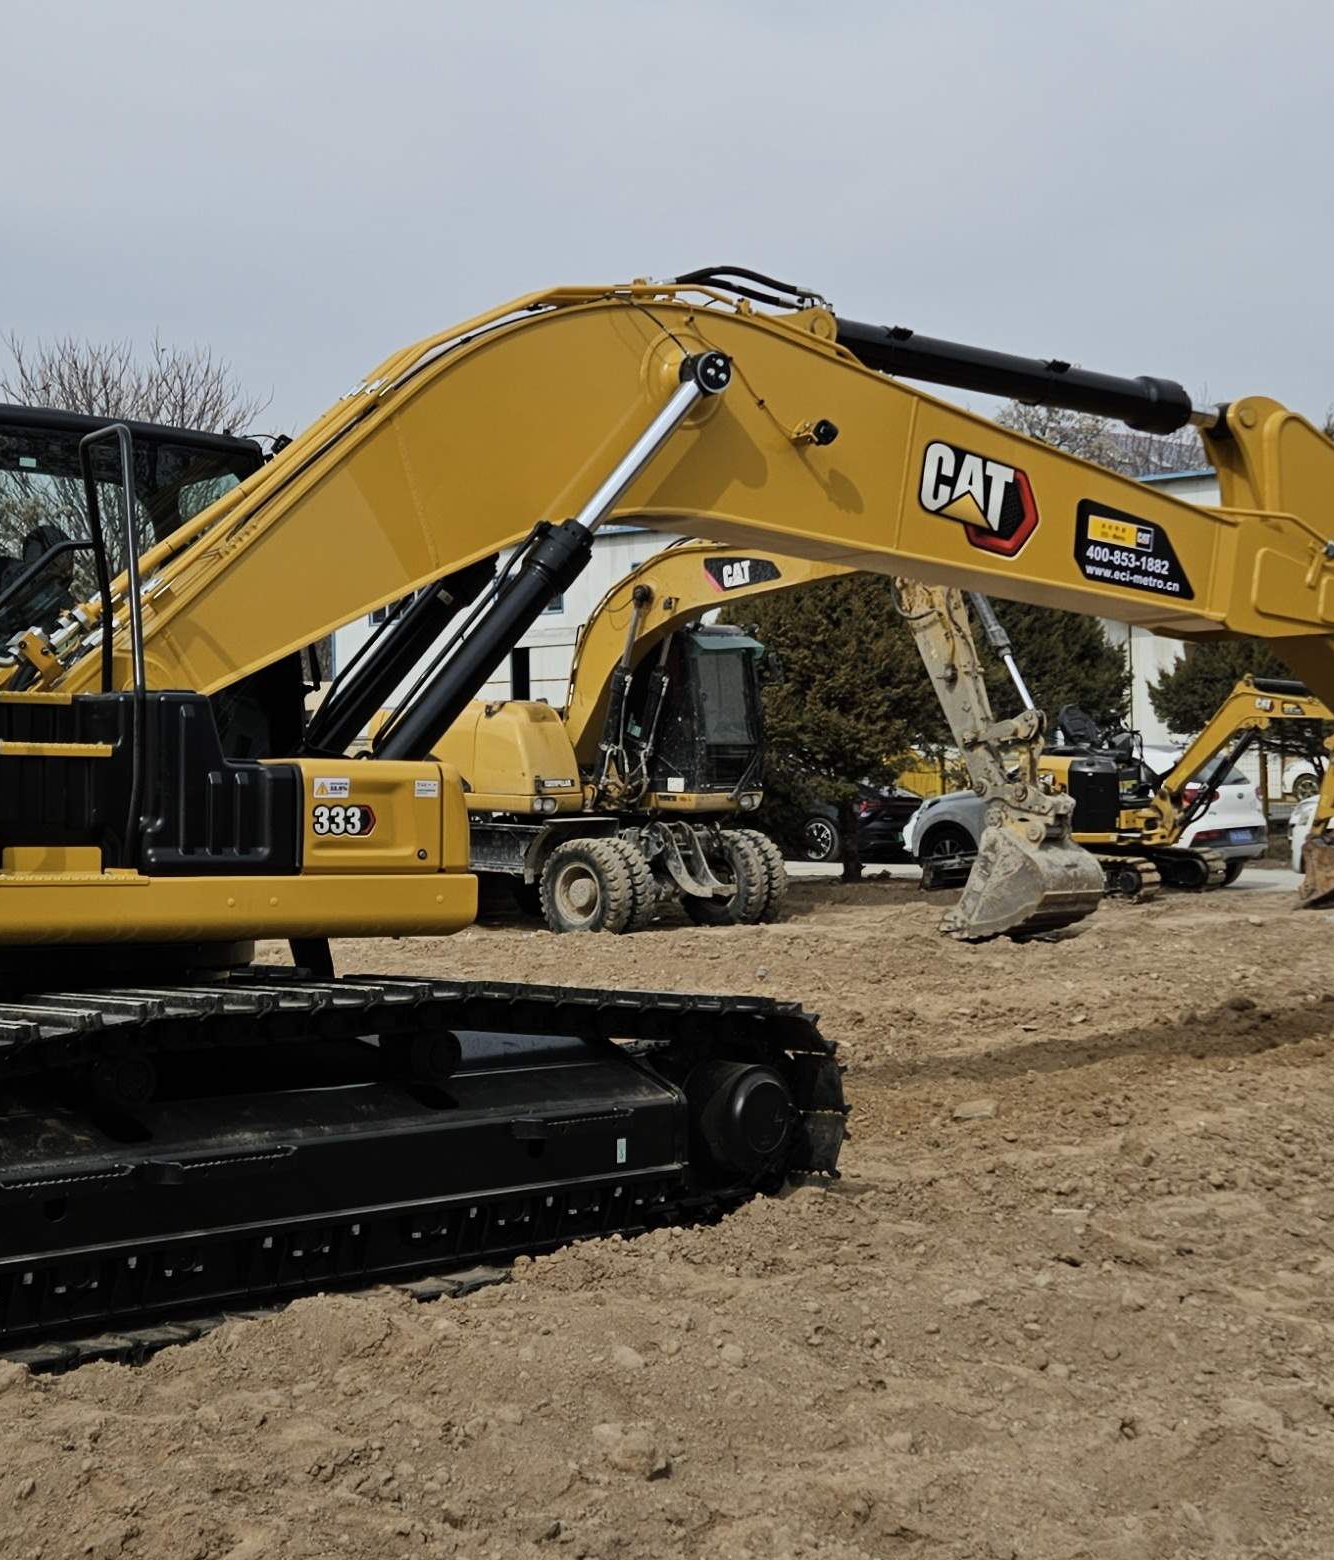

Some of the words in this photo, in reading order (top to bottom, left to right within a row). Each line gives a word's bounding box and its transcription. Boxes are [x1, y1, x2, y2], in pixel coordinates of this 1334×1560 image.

[920, 442, 1015, 531] CAT
[722, 560, 750, 588] CAT
[1086, 545, 1170, 575] 400-853-1882
[1085, 564, 1180, 592] www.eci-metro.cn
[314, 806, 361, 834] 333
